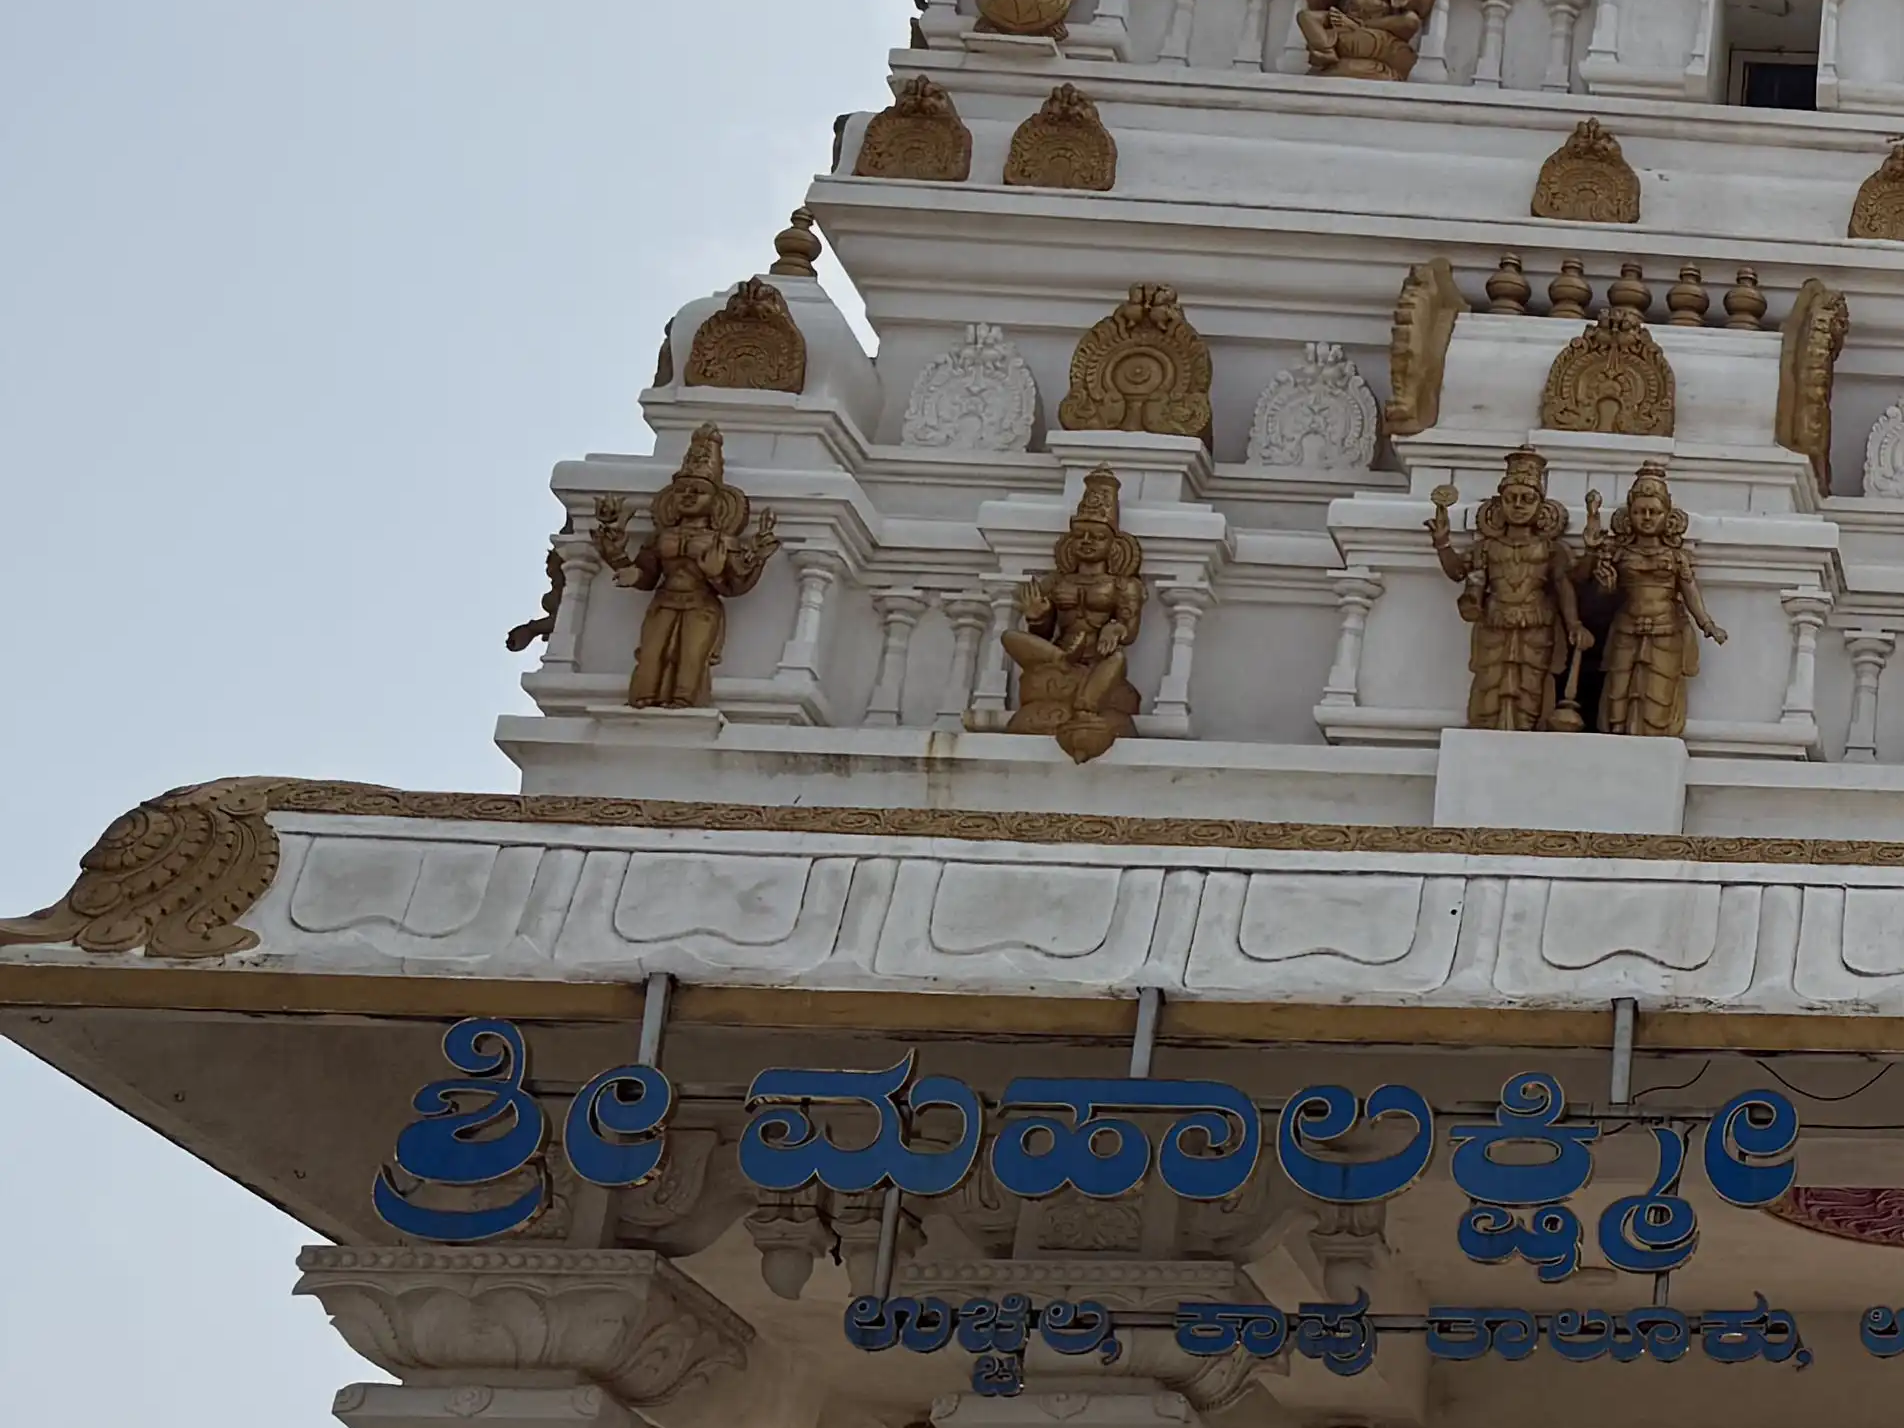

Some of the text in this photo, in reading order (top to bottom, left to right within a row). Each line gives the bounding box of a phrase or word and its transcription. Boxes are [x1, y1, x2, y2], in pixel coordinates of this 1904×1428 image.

[372, 1016, 673, 1242] ಶ್ರೀ
[736, 1047, 1799, 1284] ಮಹಾಲಕ್ಷ್ಮೀ
[1174, 1285, 1378, 1377] ಕಾಪು
